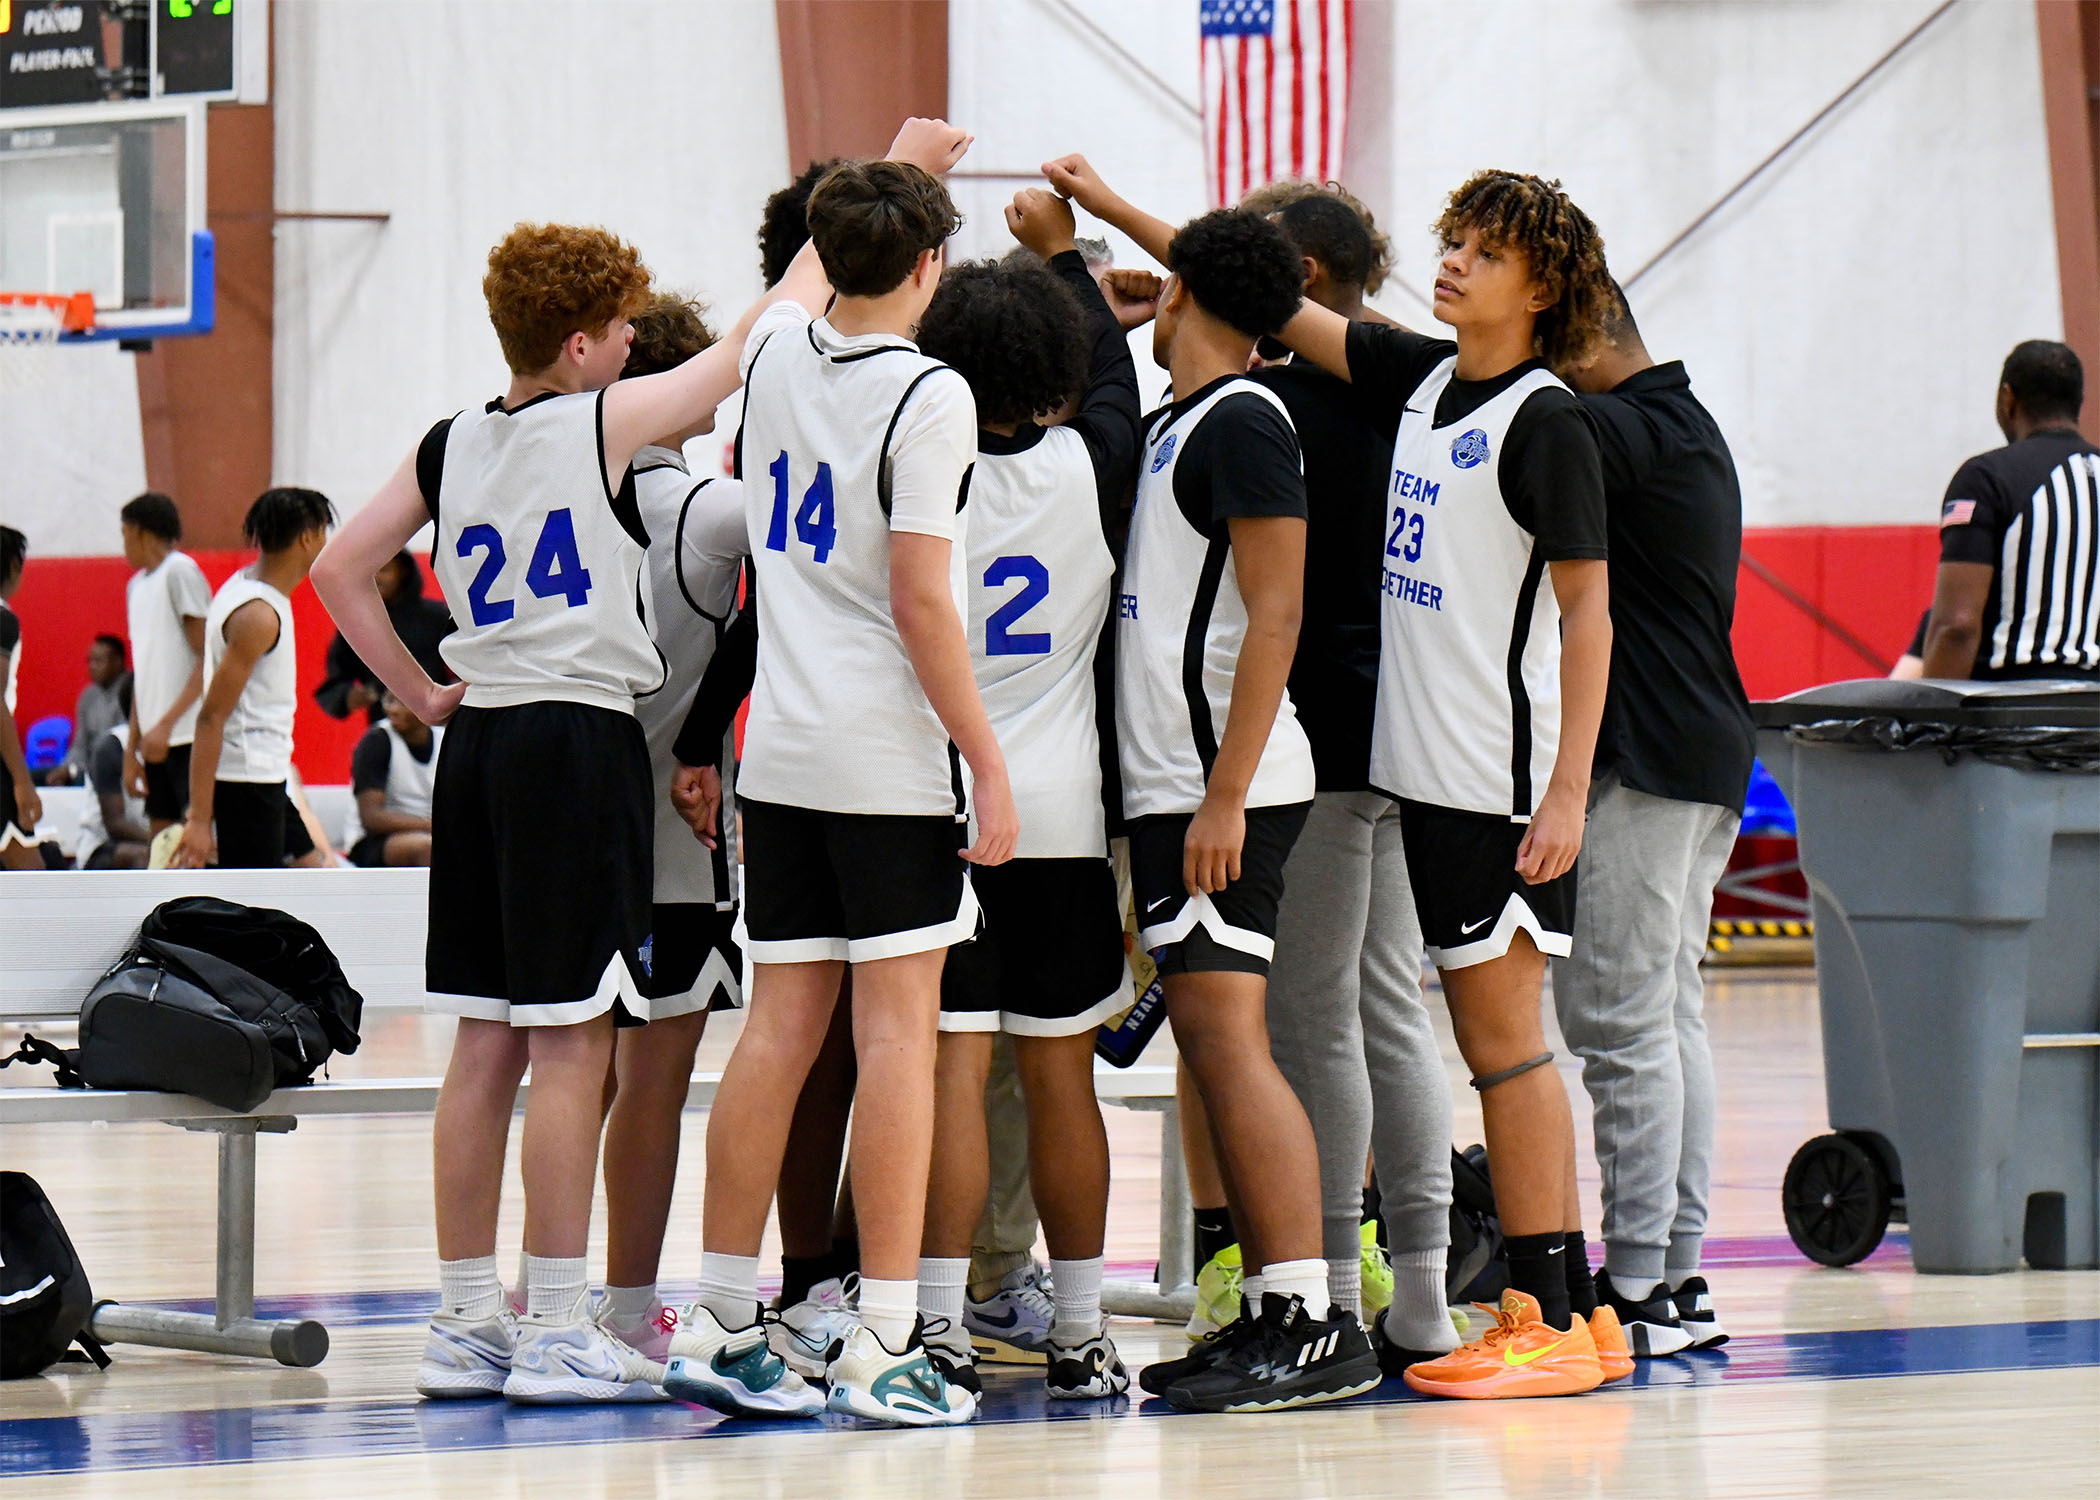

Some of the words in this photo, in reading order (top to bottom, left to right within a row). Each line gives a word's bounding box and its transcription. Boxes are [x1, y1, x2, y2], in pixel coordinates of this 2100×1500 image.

[766, 449, 837, 564] 14
[1394, 469, 1441, 506] TEAM
[456, 507, 593, 627] 24
[1386, 506, 1425, 563] 23
[983, 555, 1051, 656] 2
[1125, 977, 1163, 1031] EAVEN
